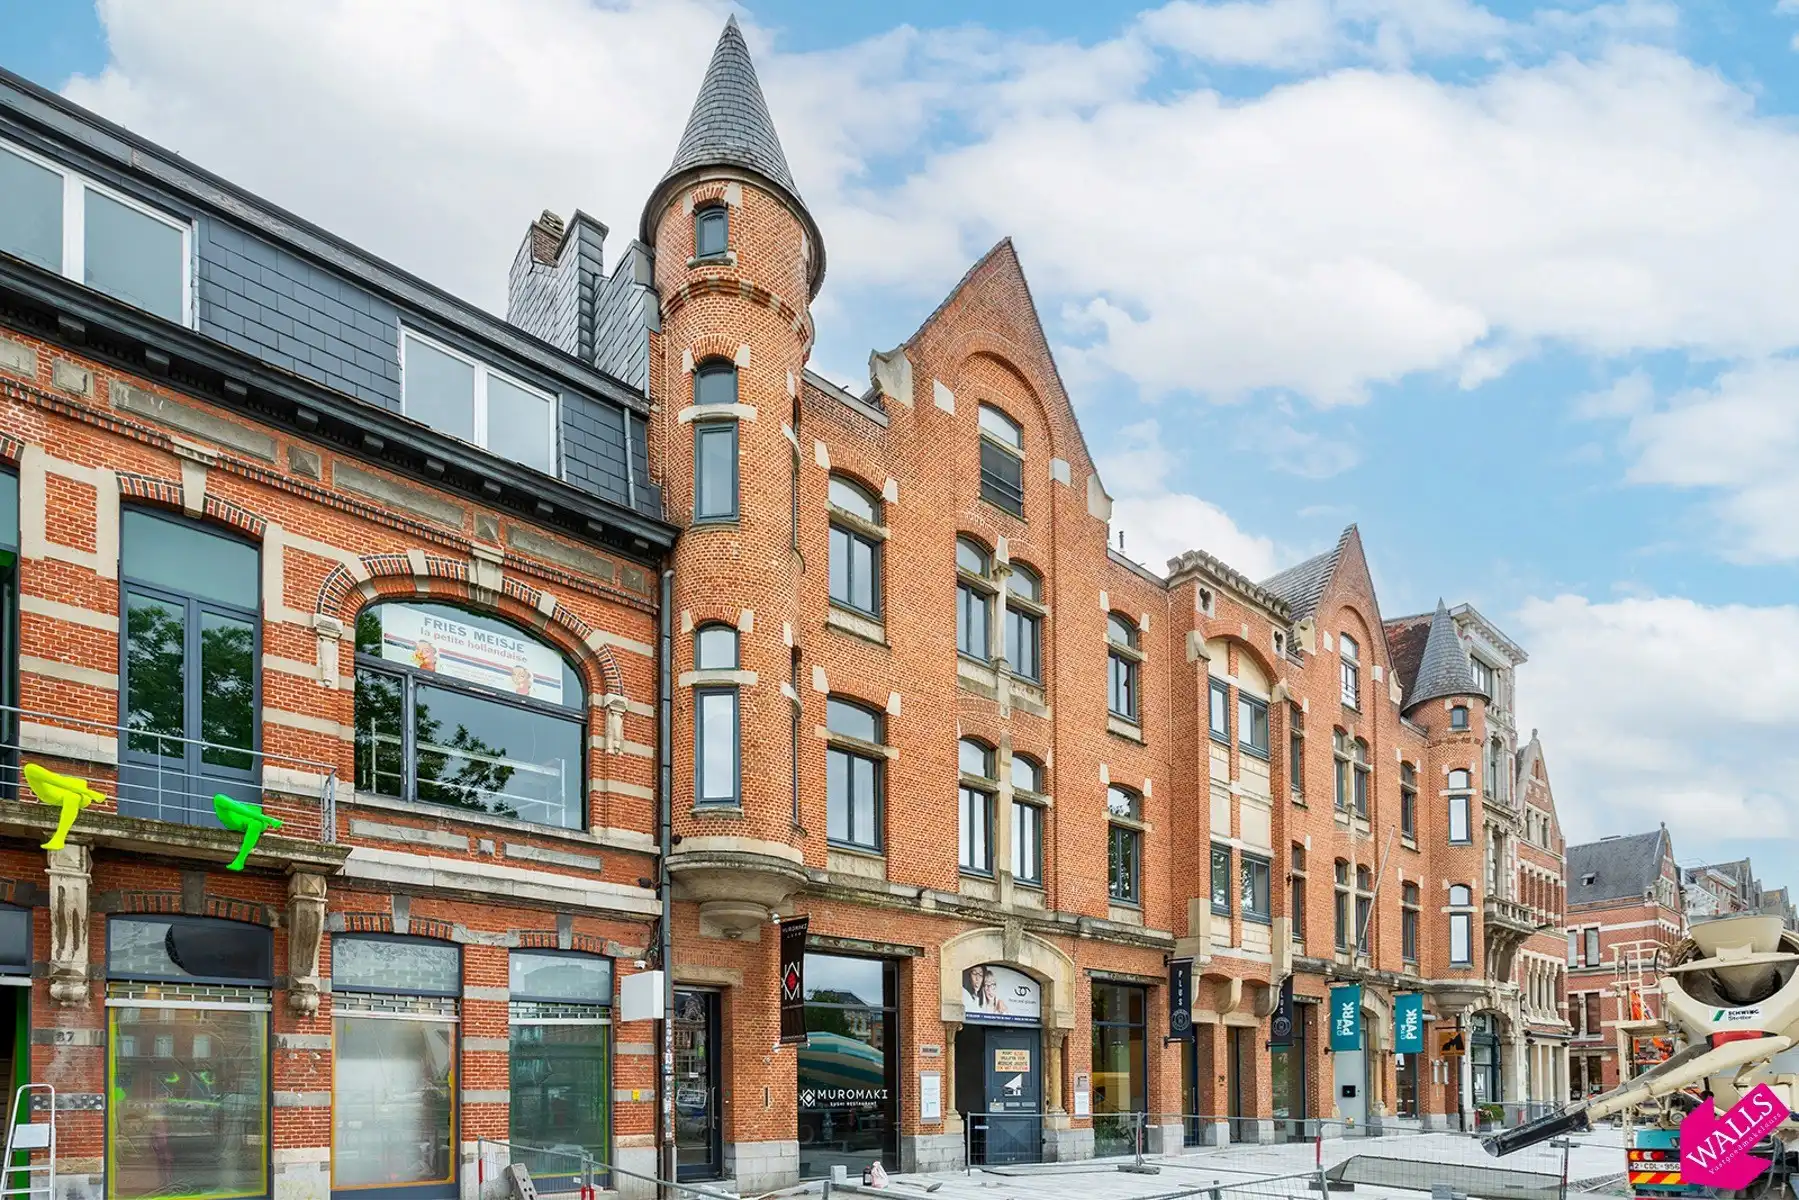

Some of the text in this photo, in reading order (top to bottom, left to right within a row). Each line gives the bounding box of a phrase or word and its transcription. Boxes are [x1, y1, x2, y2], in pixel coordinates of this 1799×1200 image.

[420, 627, 528, 663] la petite hollandaise
[424, 617, 525, 653] FRIES MEISJE
[1342, 1001, 1354, 1036] PARK
[1406, 1008, 1417, 1040] PARK
[817, 1089, 888, 1100] MUROMAKI
